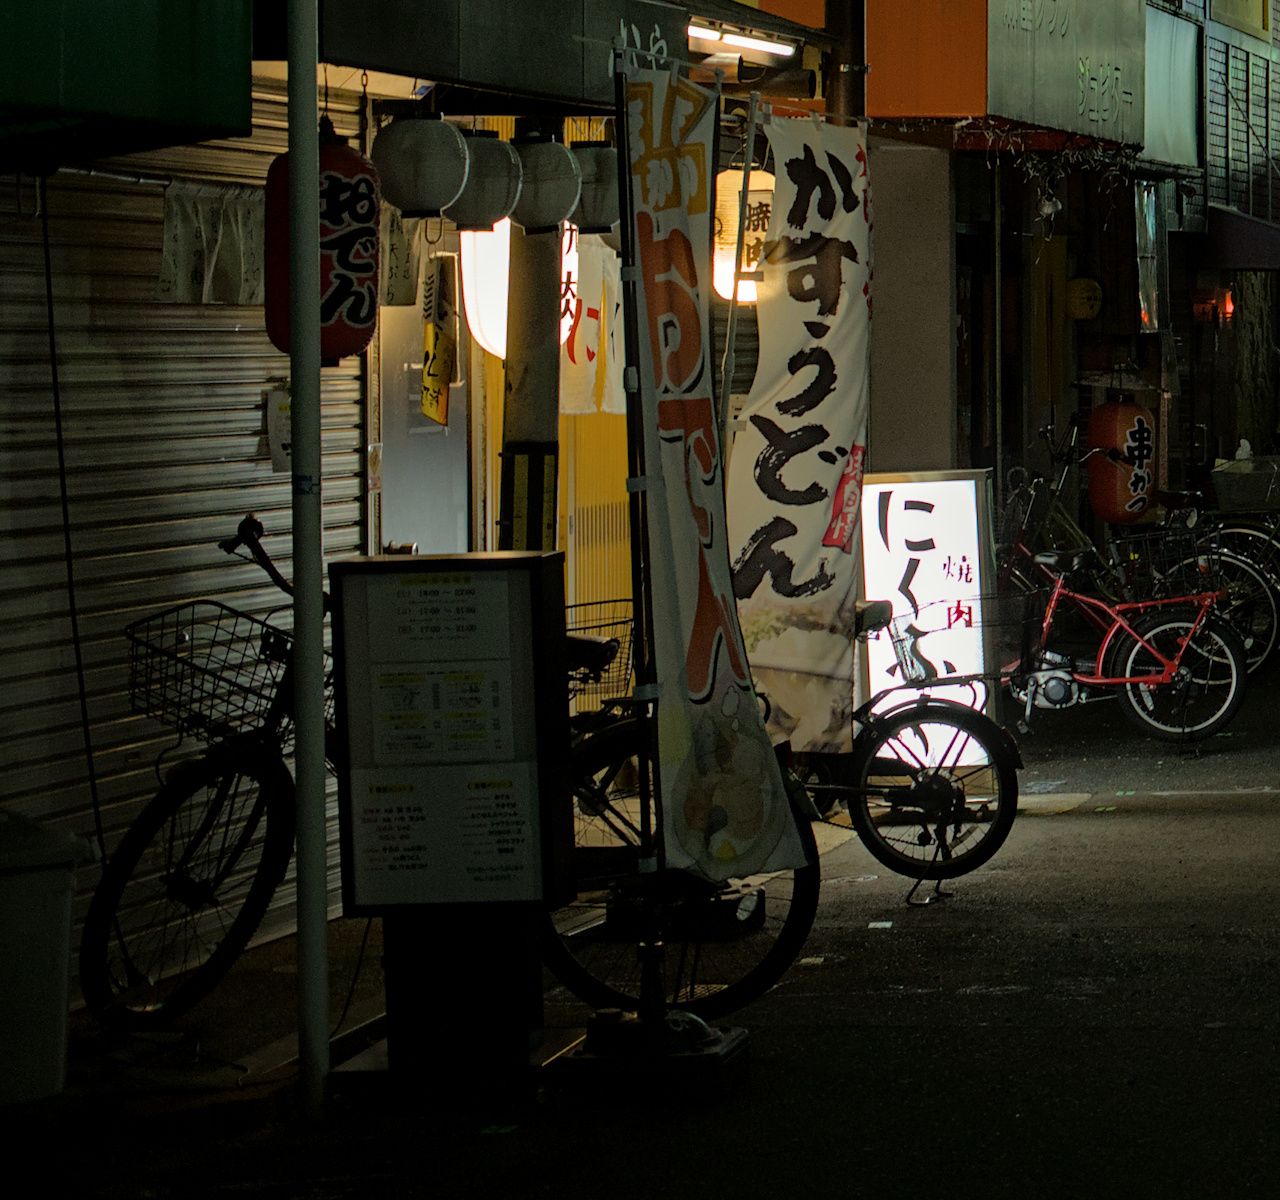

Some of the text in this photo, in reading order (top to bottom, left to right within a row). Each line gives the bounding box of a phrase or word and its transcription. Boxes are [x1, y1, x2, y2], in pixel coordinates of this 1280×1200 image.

[733, 142, 860, 600] かすうどん
[943, 555, 973, 630] 焼肉
